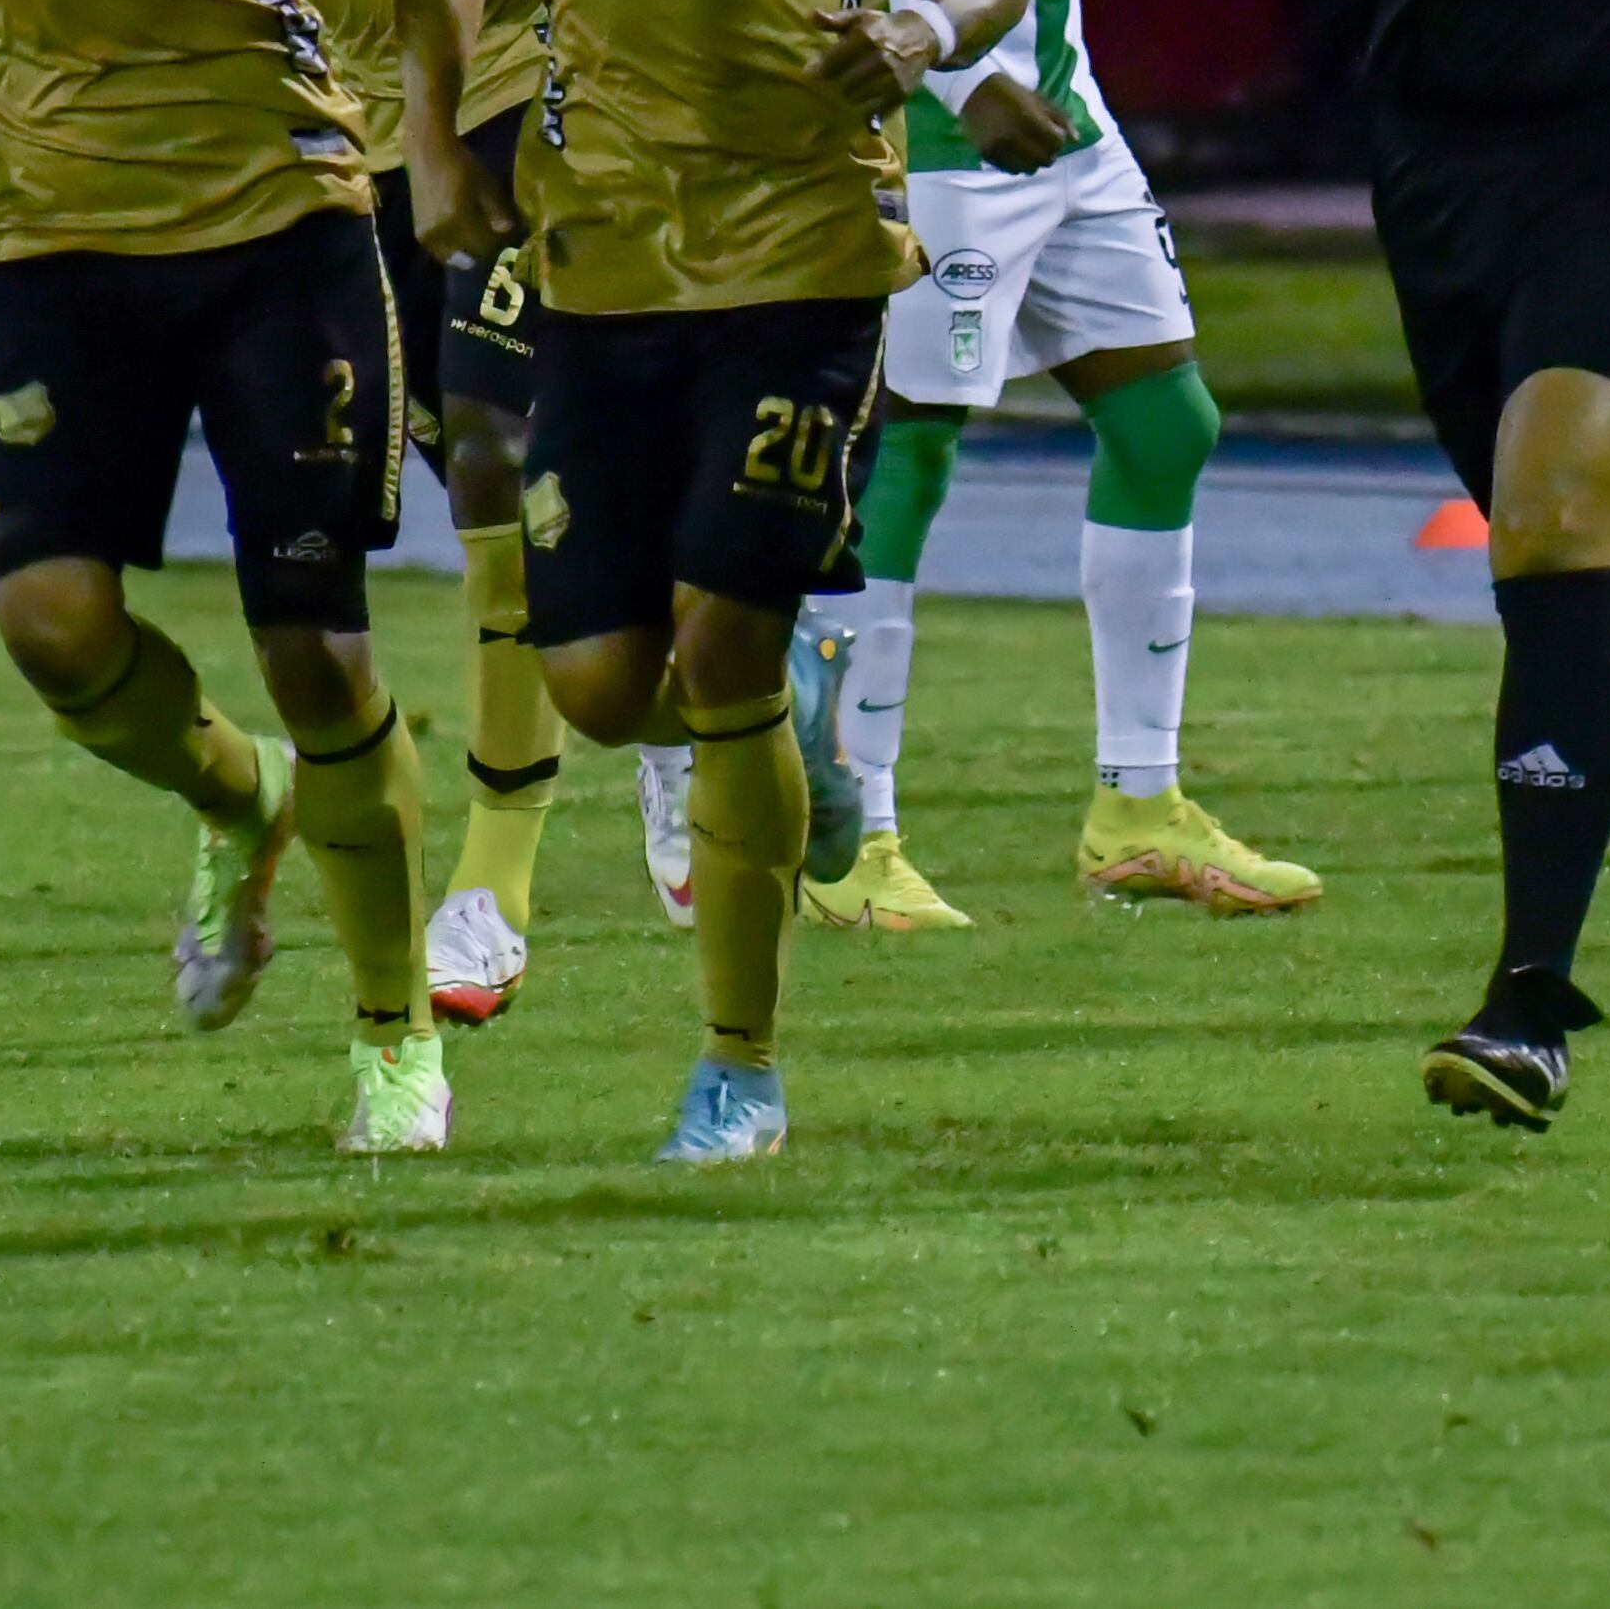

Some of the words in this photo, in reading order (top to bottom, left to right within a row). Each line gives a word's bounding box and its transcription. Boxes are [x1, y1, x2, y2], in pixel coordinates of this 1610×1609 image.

[941, 263, 995, 280] ARESS
[325, 358, 355, 444] 2
[745, 395, 834, 490] 20
